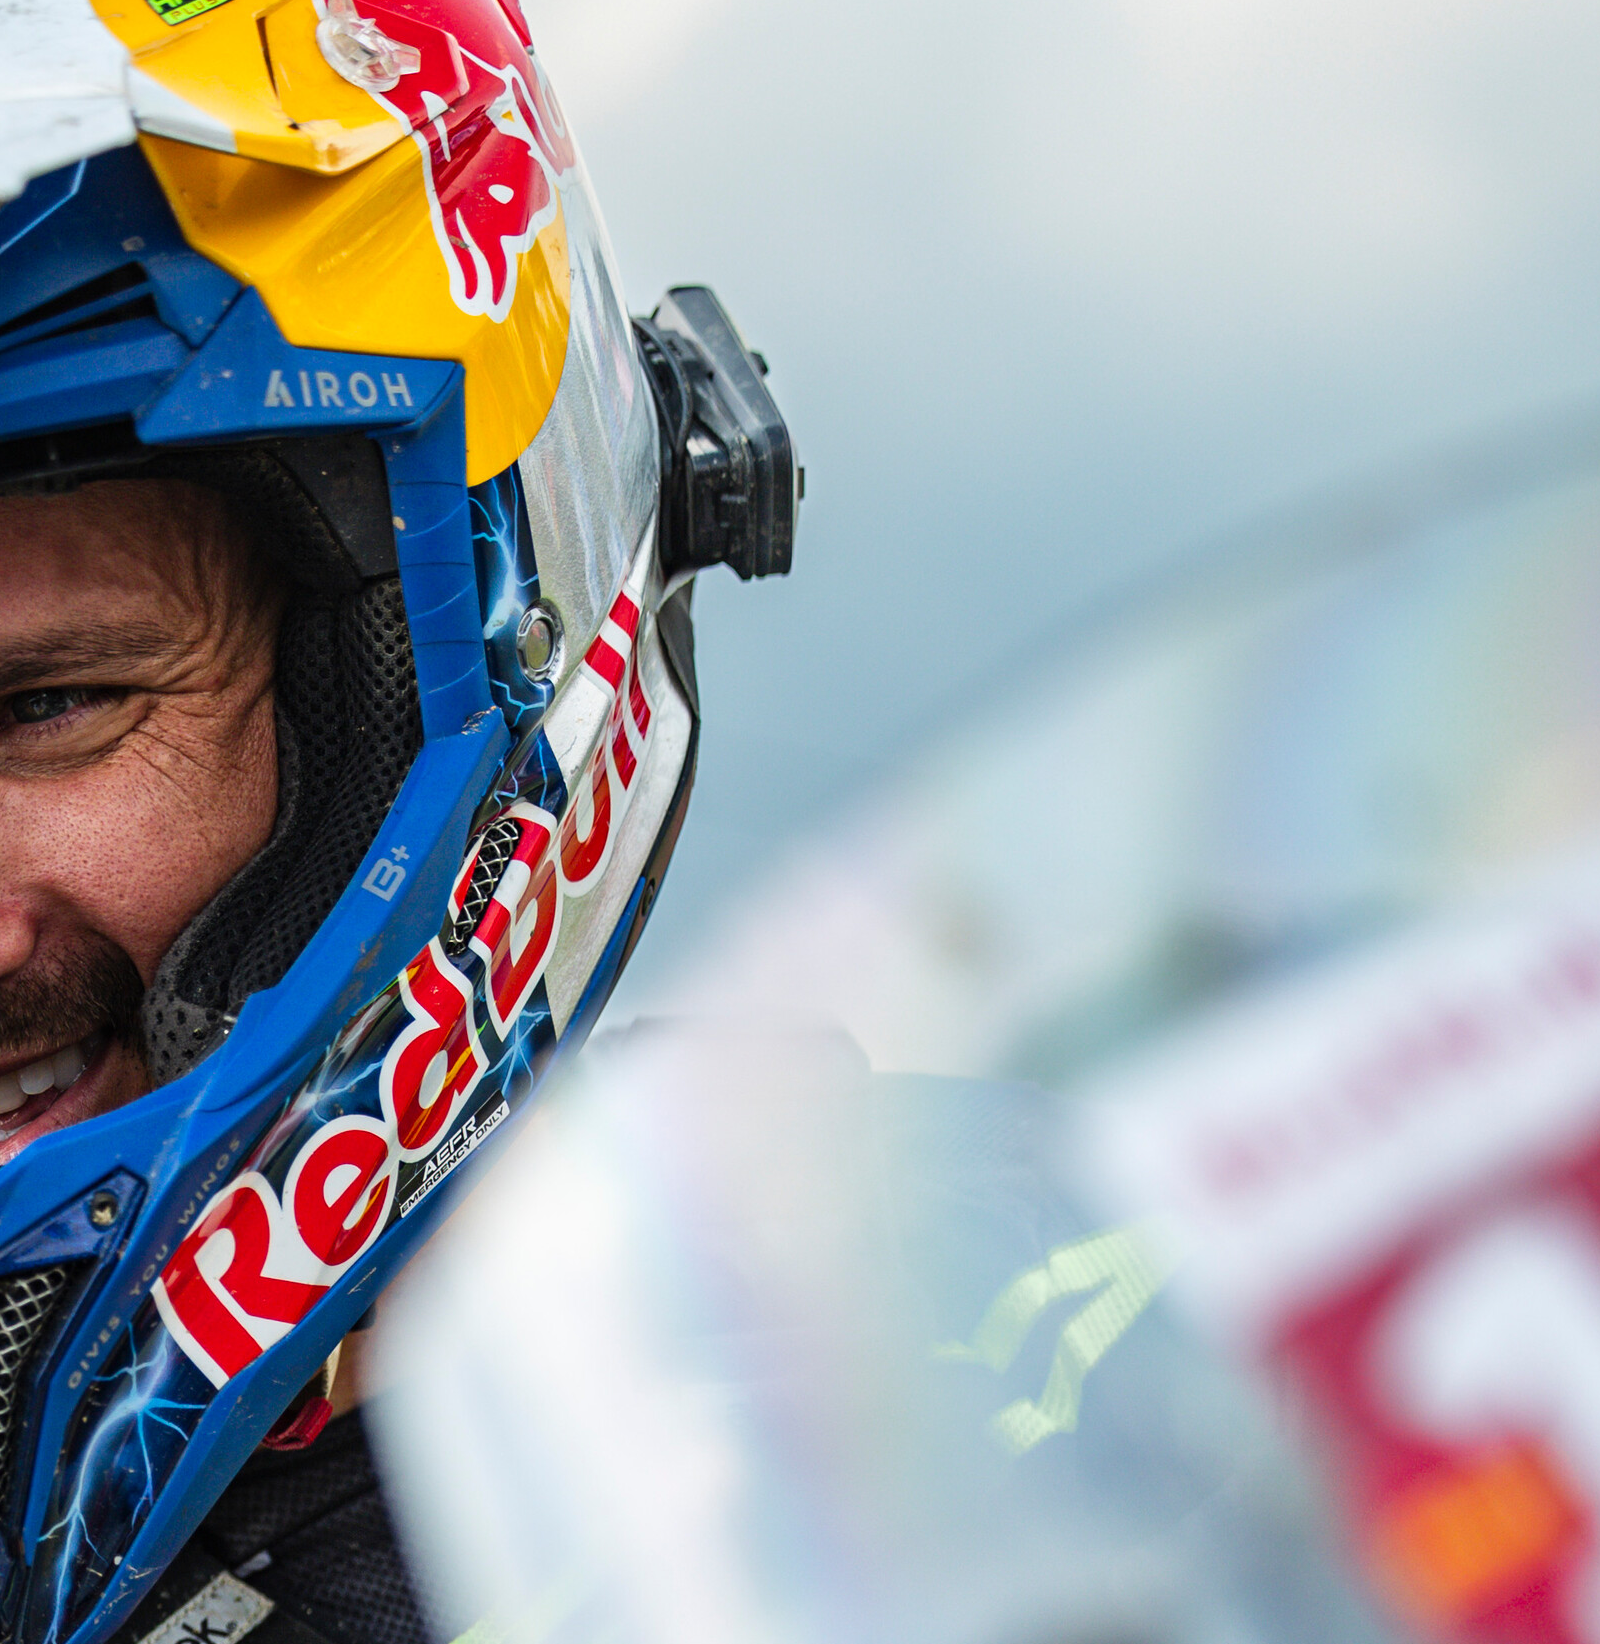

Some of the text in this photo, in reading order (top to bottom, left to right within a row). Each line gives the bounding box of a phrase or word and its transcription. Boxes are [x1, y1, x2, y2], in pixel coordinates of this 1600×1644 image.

[264, 371, 414, 409] AIROH
[155, 586, 653, 1386] Red Bull
[401, 1105, 505, 1214] EMERGENCY ONLY
[422, 1115, 478, 1183] AEFR
[68, 1138, 241, 1390] GIVES YOU WINGS
